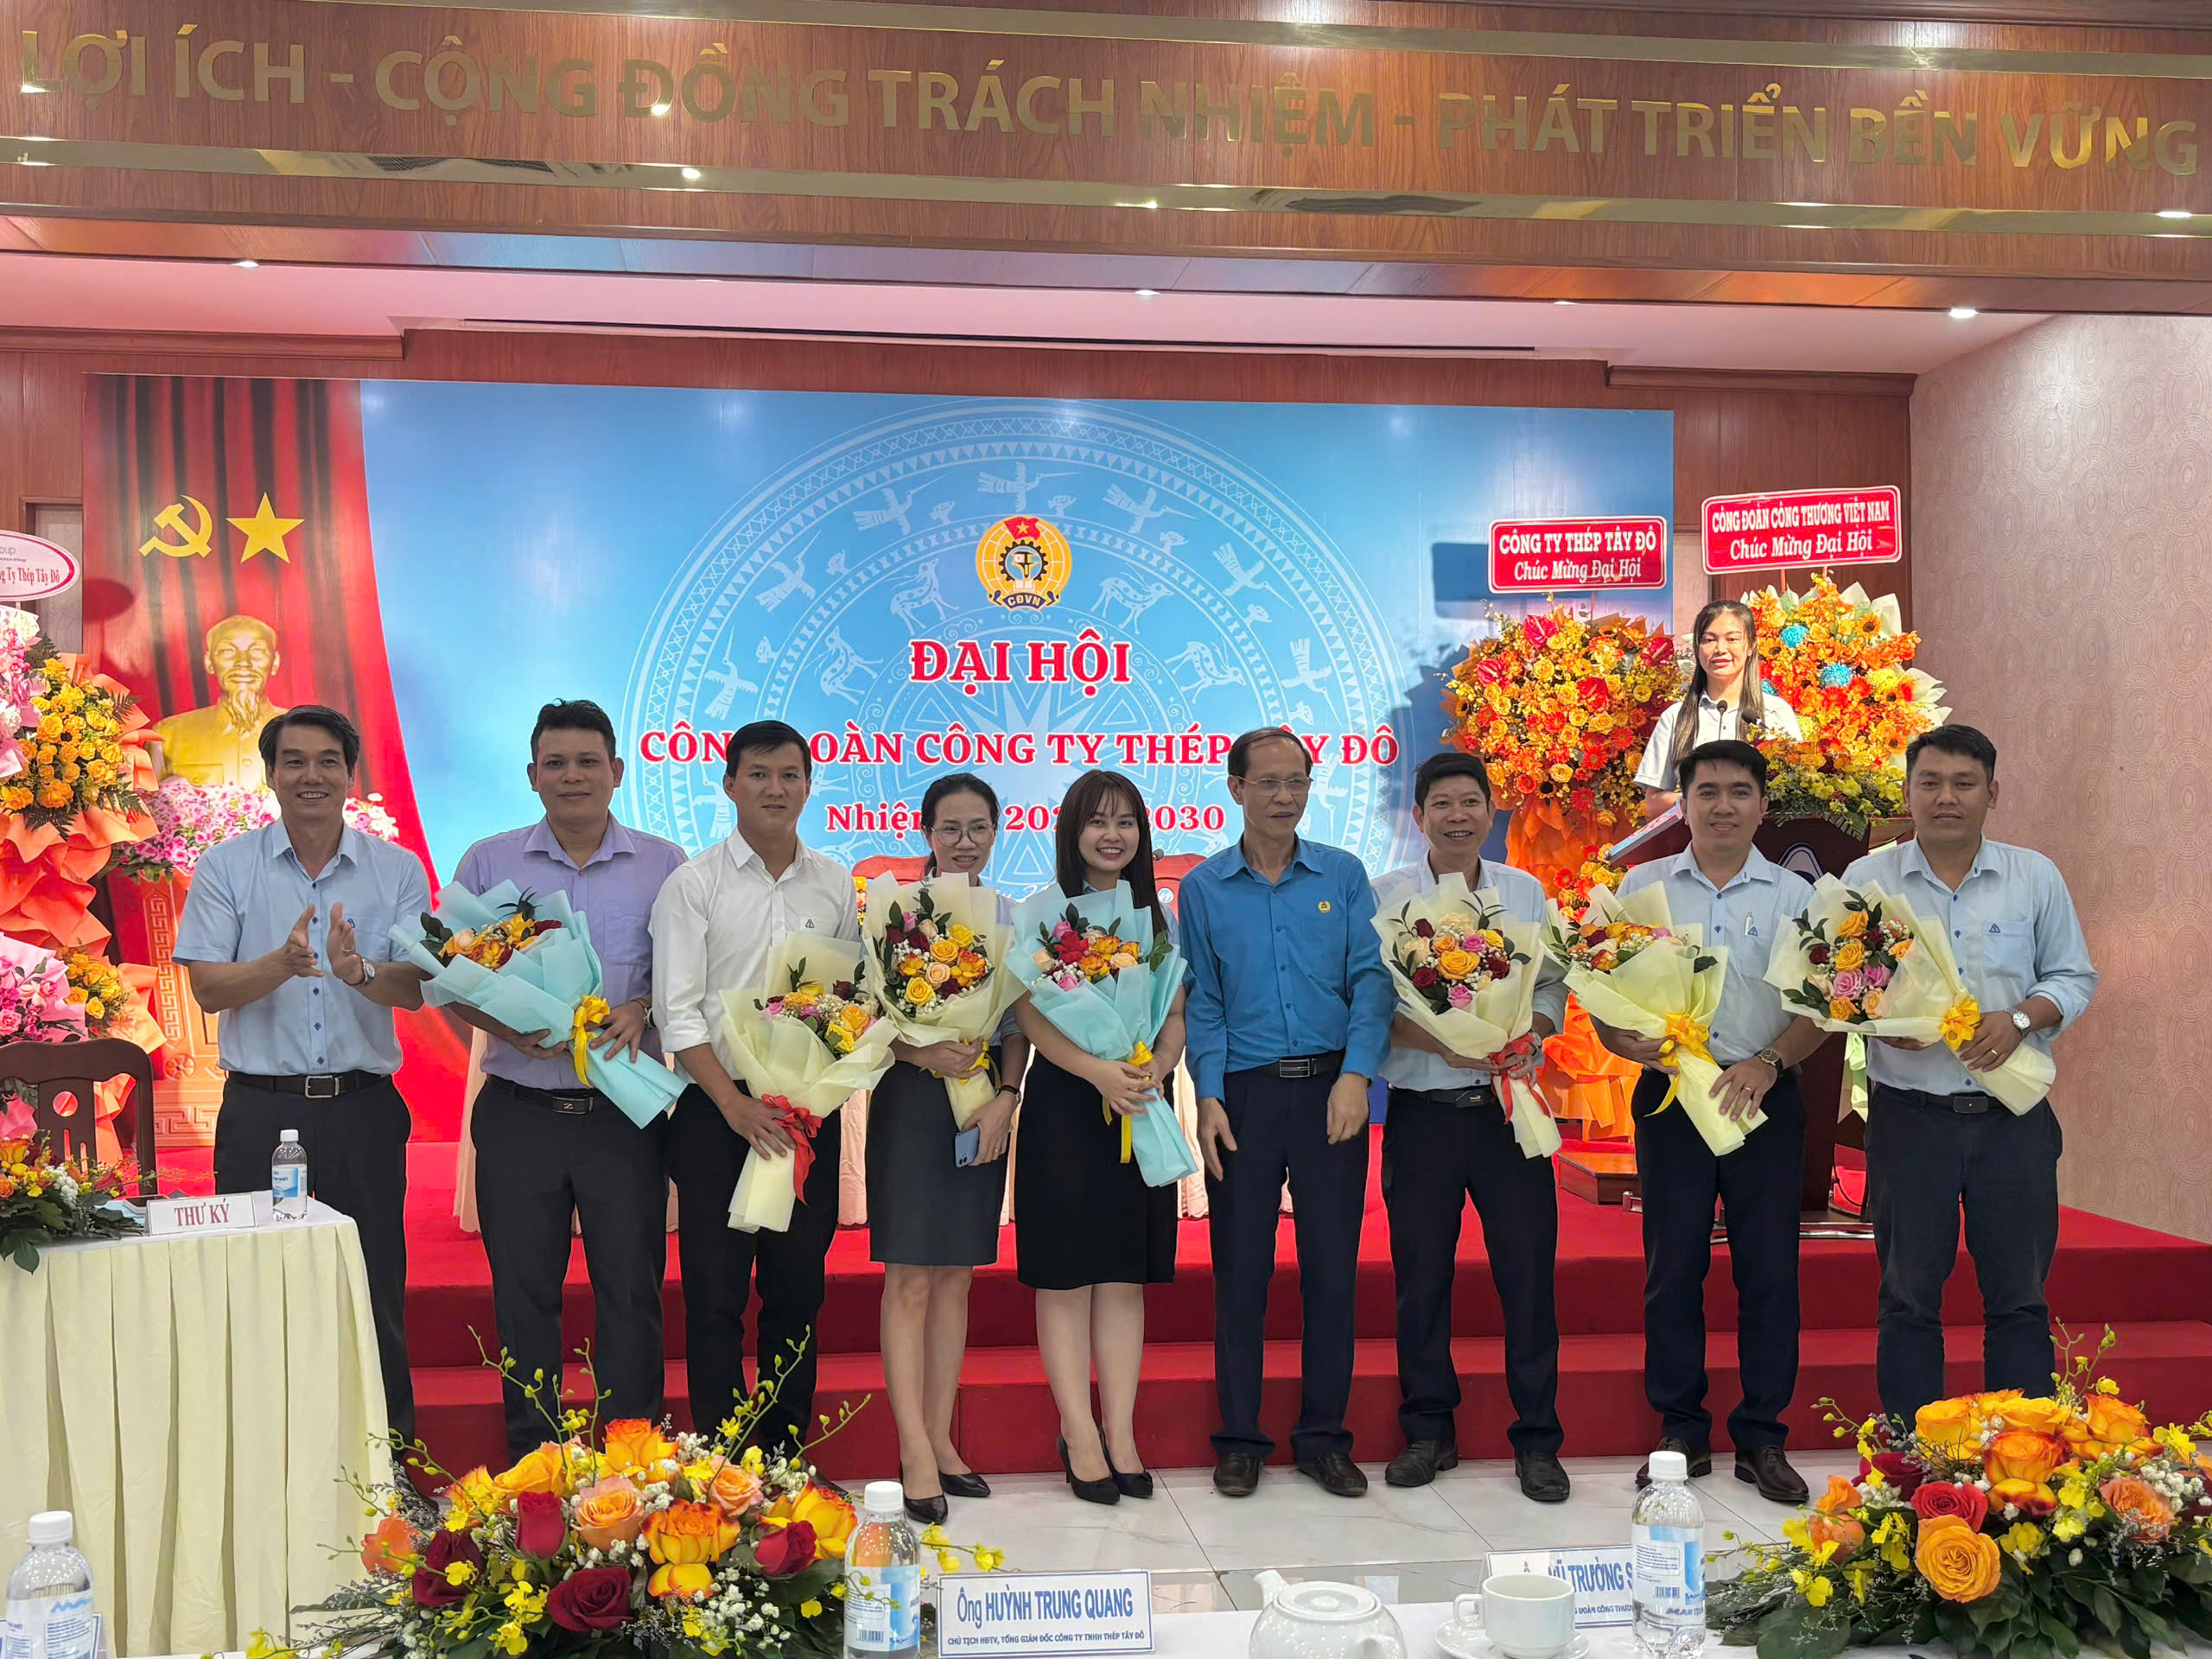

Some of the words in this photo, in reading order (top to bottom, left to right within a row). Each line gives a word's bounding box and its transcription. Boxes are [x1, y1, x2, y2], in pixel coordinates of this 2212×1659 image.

[21, 29, 147, 111] LỢI
[175, 23, 305, 104] ÍCH
[374, 35, 595, 126] CỘNG
[618, 42, 849, 129] ĐỒNG
[868, 59, 1115, 137] TRÁCH
[1140, 72, 1375, 158] NHIỆM
[1437, 83, 1618, 156] PHÁT
[1631, 83, 1827, 163] TRIỂN
[1848, 90, 1977, 166] BỀN
[1998, 102, 2197, 175] VỮNG
[1712, 506, 1740, 532] CÔNG
[1771, 501, 1799, 528] CÔNG
[1867, 501, 1891, 521] NAM
[1499, 529, 1541, 554] CÔNG
[1544, 532, 1563, 553] TY
[1565, 527, 1602, 552] THÉP
[1605, 525, 1633, 551] TÂY
[1635, 525, 1656, 551] ĐÔ
[1730, 537, 1767, 560] Chúc
[1771, 534, 1812, 560] Mừng
[1815, 531, 1842, 558] Đại
[1847, 529, 1872, 557] Hội
[17, 567, 35, 586] Thép
[1515, 560, 1548, 581] Chúc
[1551, 558, 1587, 583] Mừng
[1592, 559, 1615, 583] Đại
[1619, 557, 1642, 582] Hội
[910, 640, 1012, 695] ĐẠI
[1027, 628, 1131, 696] HỘI
[639, 721, 733, 763] CÔN
[810, 720, 905, 764] OÀN
[915, 722, 1036, 765] CÔNG
[1046, 734, 1103, 764] TY
[1115, 722, 1232, 765] THÉP
[1341, 725, 1400, 765] ĐÔ
[1004, 805, 1061, 830] 20
[1147, 805, 1225, 830] 030
[175, 1202, 207, 1227] THƯ
[210, 1198, 230, 1224] KÝ
[1567, 1556, 1624, 1592] TRƯỜNG
[957, 1586, 982, 1629] Ông
[985, 1584, 1032, 1621] HUỲNH
[1034, 1589, 1081, 1619] TRUNG
[1084, 1587, 1134, 1620] QUANG
[1103, 1631, 1120, 1640] THÉP
